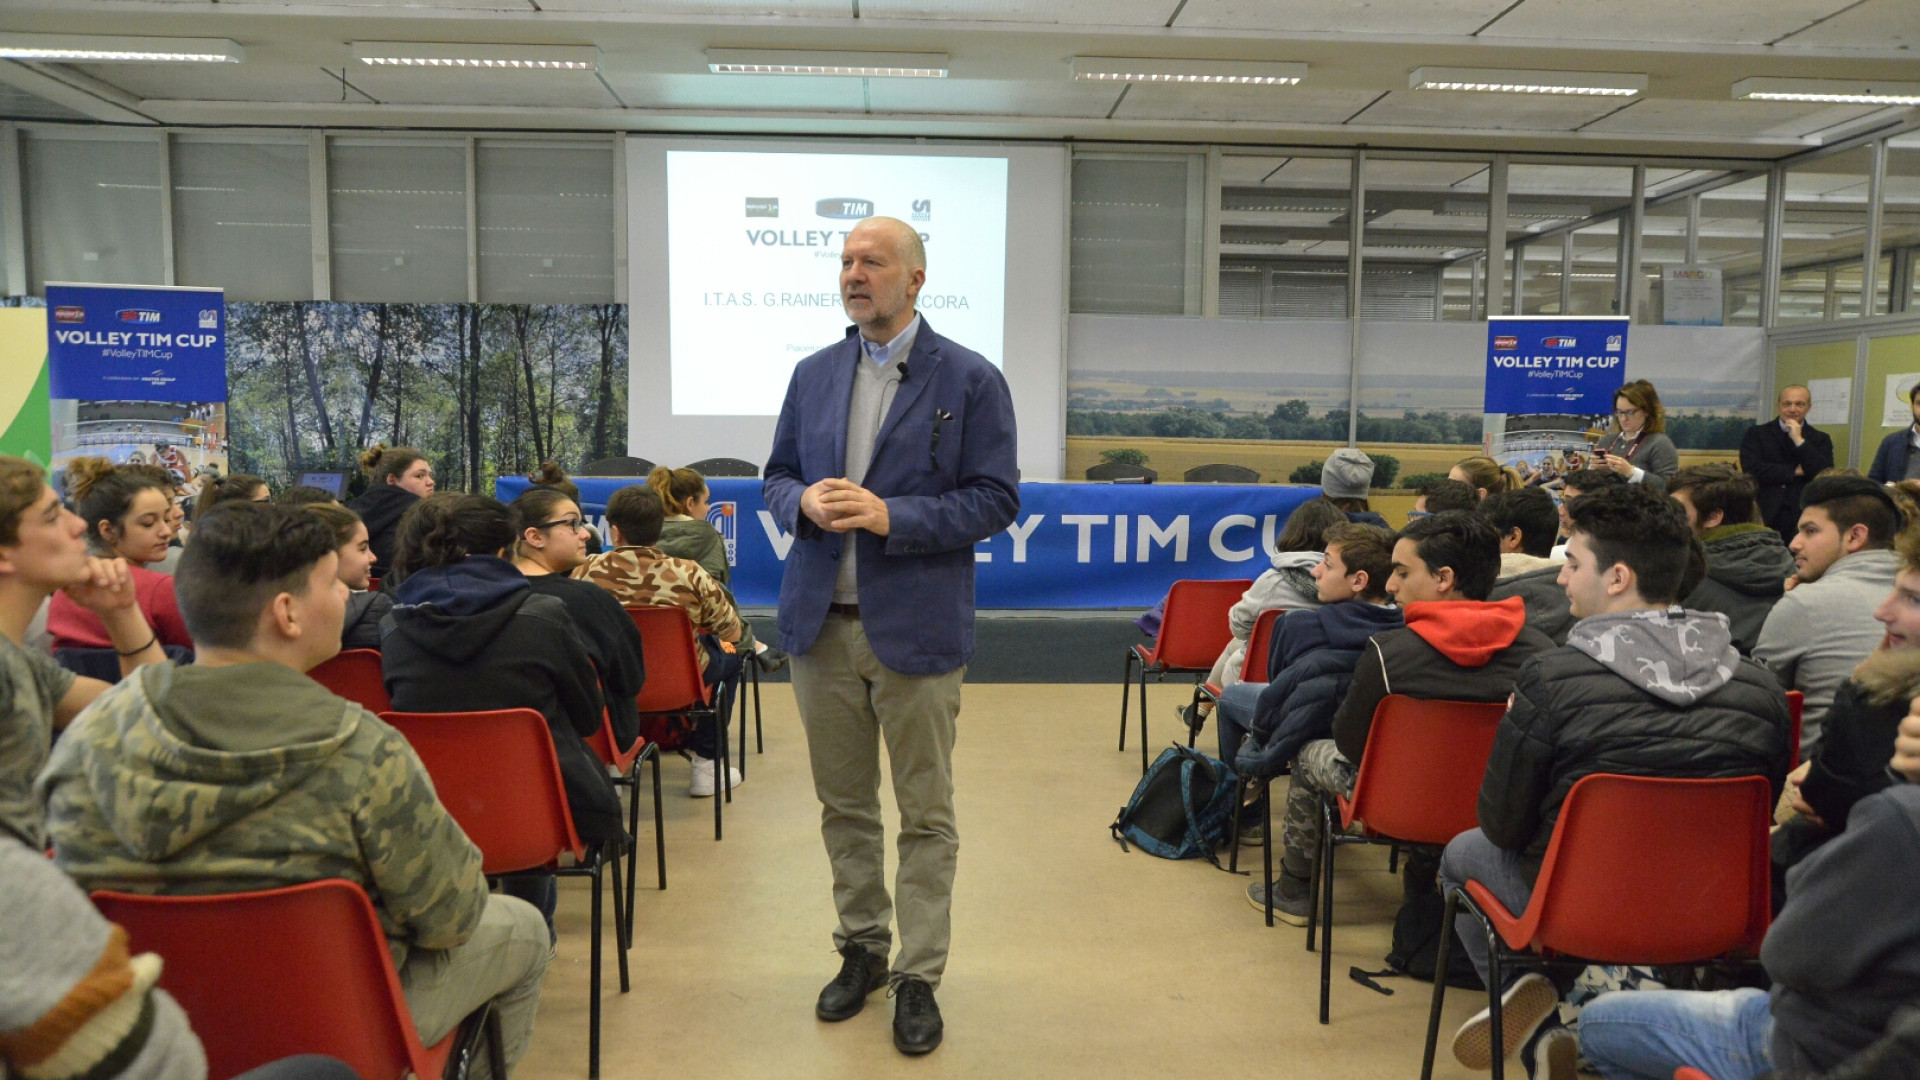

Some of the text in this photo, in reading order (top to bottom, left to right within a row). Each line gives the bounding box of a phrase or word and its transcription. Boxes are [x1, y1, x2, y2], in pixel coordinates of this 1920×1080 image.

[842, 202, 868, 216] TIM
[745, 229, 833, 247] VOLLEY
[704, 292, 757, 307] I.T.A.S.
[763, 292, 843, 307] G.RAINER
[138, 311, 161, 323] TIM
[55, 330, 217, 348] VOLLEY TIM CUP
[1558, 338, 1577, 348] TIM
[102, 348, 173, 361] #VolleyTIMCup
[1493, 356, 1620, 368] VOLLEY TIM CUP
[1061, 514, 1190, 564] TIM
